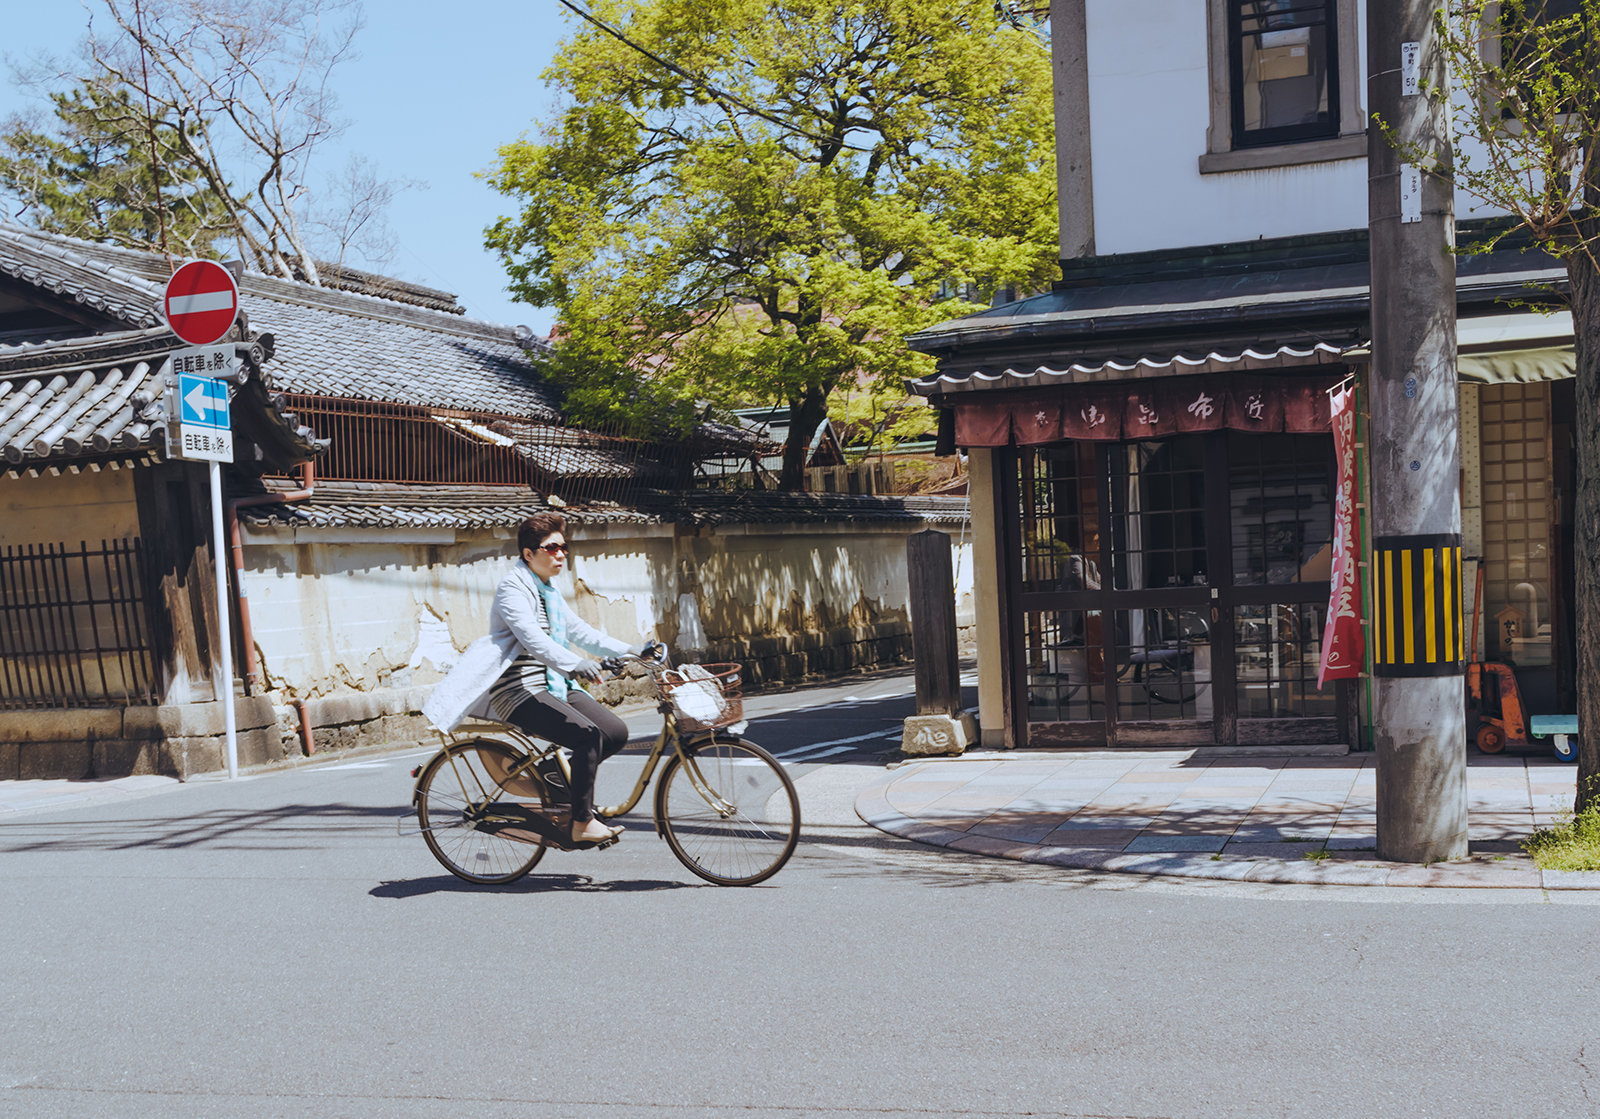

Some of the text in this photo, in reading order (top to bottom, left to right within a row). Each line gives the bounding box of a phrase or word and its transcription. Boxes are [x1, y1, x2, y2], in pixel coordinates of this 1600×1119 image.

[173, 351, 232, 375] 自転車を除く
[185, 433, 231, 455] 自転車を除く
